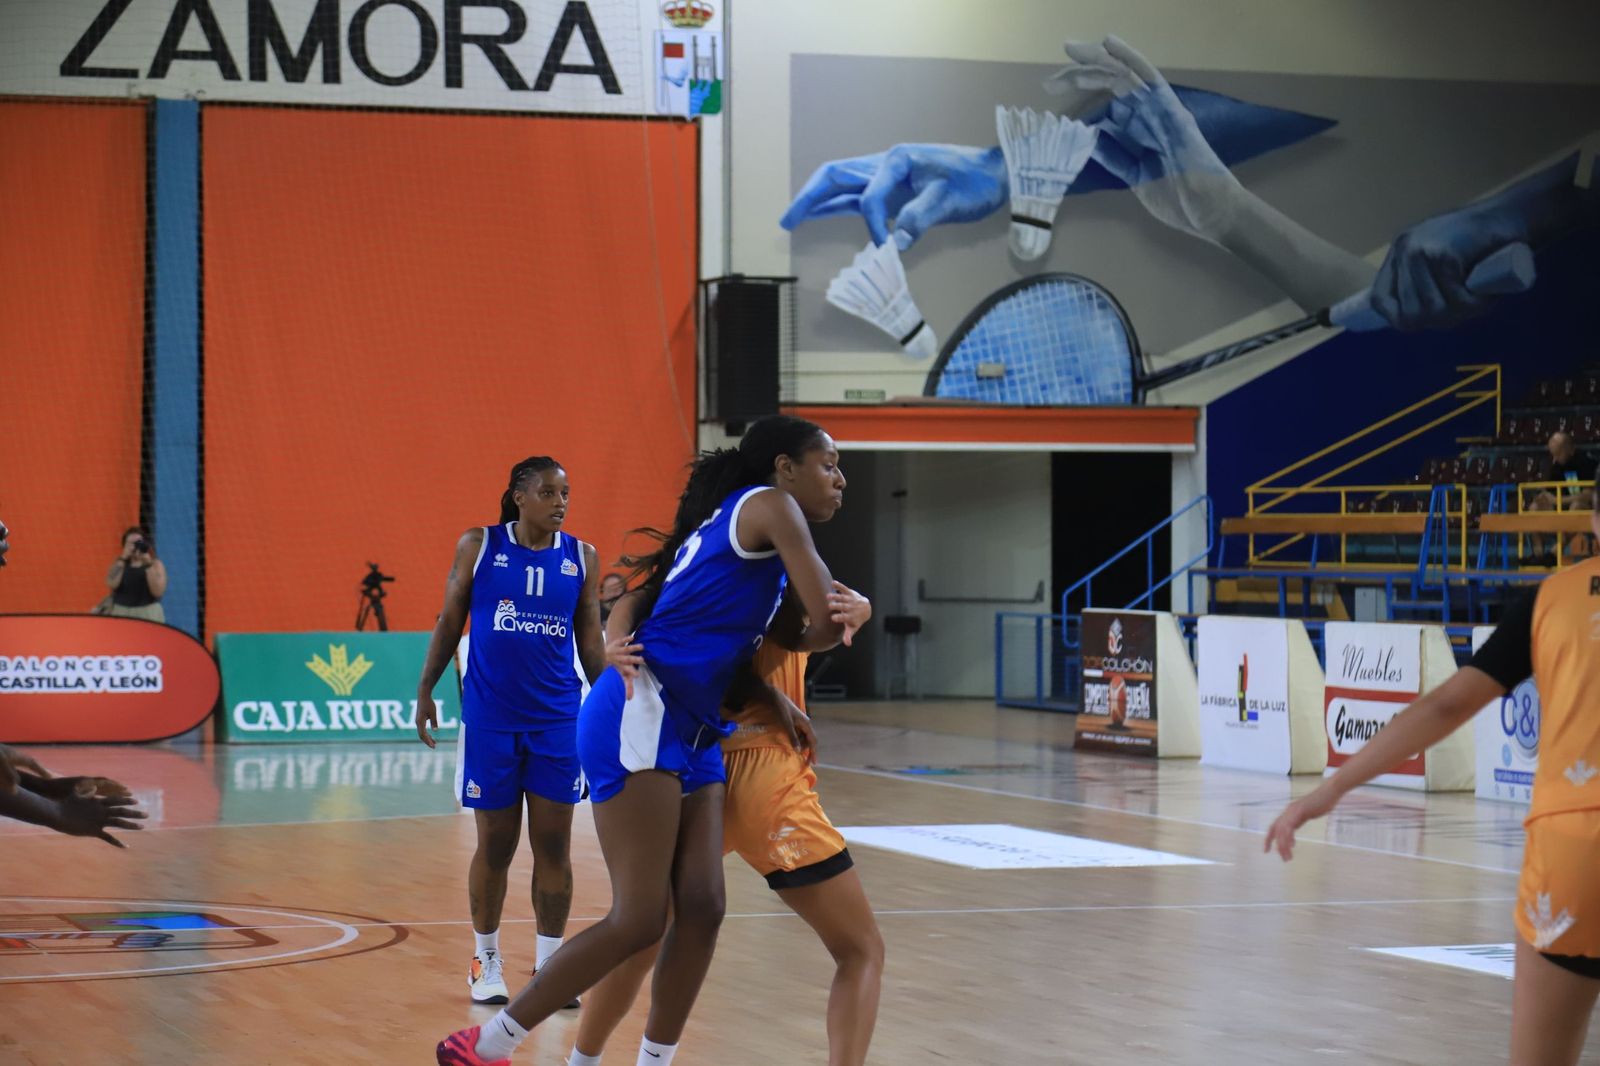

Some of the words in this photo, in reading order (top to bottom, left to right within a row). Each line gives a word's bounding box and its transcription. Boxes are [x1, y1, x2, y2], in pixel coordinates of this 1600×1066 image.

[60, 0, 623, 95] ZAMORA
[525, 566, 544, 596] 11
[0, 659, 158, 672] BALONCESTO
[1342, 643, 1403, 682] Muebles
[0, 676, 87, 689] CASTILLA
[92, 676, 103, 688] Y
[109, 673, 158, 688] LEÓN
[233, 701, 327, 733] CAJA
[1249, 699, 1259, 709] DE
[1260, 701, 1270, 711] LA
[1271, 702, 1287, 712] LUZ
